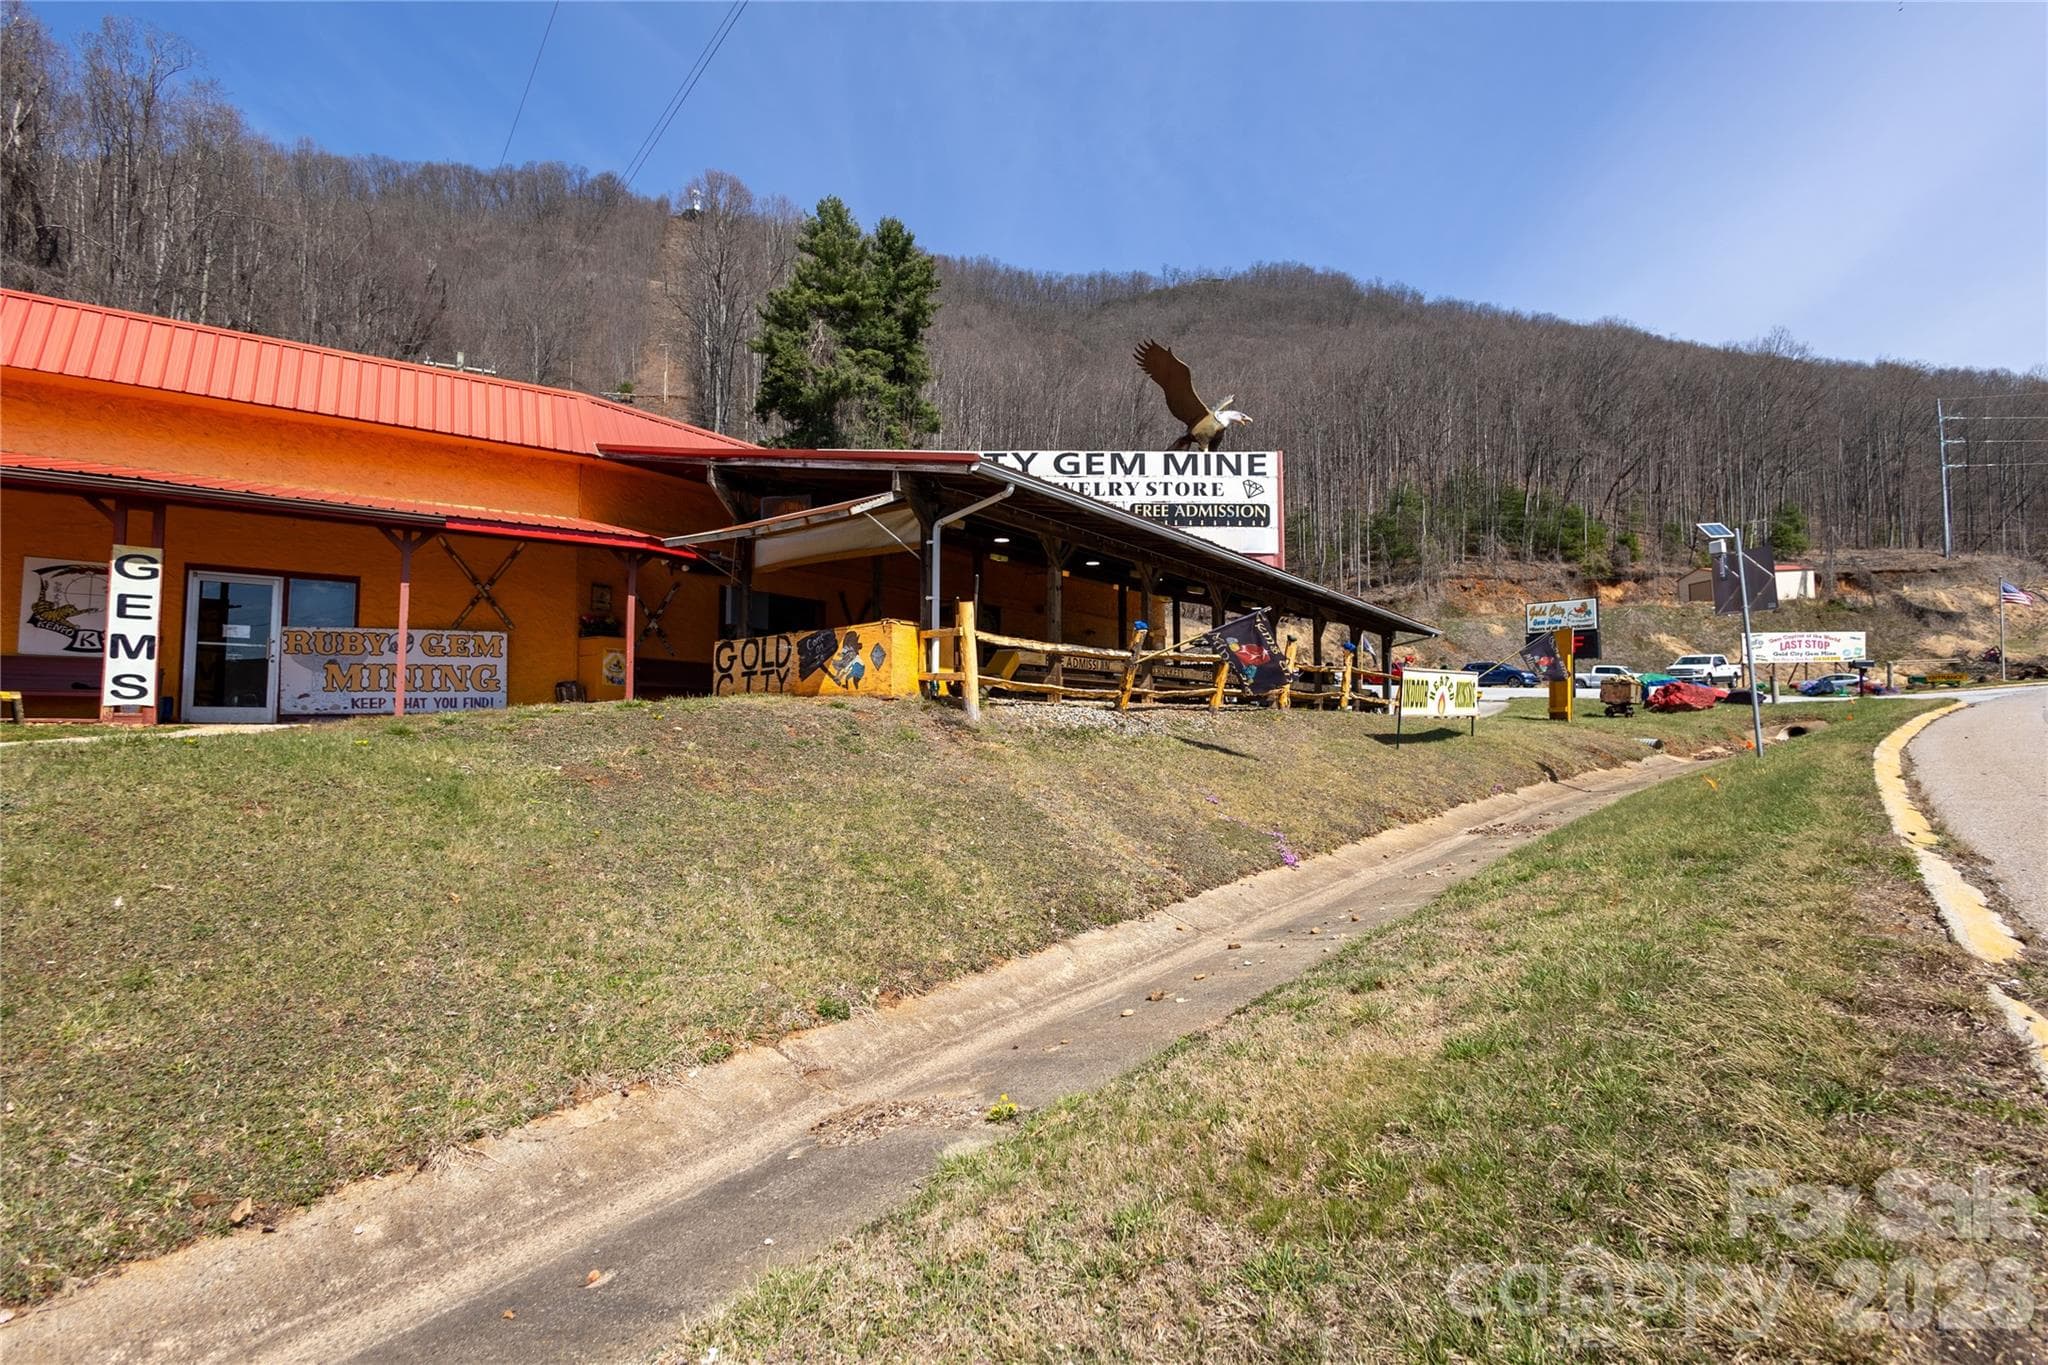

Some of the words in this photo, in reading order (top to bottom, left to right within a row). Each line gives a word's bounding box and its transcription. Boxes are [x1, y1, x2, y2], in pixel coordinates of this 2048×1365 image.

[1053, 452, 1146, 476] GEM
[1163, 453, 1267, 477] MINE
[1145, 481, 1225, 497] STORE
[1134, 504, 1169, 518] FREE
[1174, 504, 1267, 518] ADMISSION
[109, 553, 160, 700] GEMS
[282, 630, 390, 656] RUBY
[420, 632, 504, 658] GEM
[715, 634, 793, 674] GOLD
[1779, 639, 1802, 651] LAST
[1804, 639, 1831, 650] STOP
[322, 662, 501, 693] MINING
[351, 697, 387, 710] KEEP
[393, 697, 428, 709] HAT
[433, 697, 458, 710] YOU
[462, 697, 495, 709] FIND!
[1402, 679, 1428, 708] INDOOR
[1429, 675, 1455, 701] HEATED
